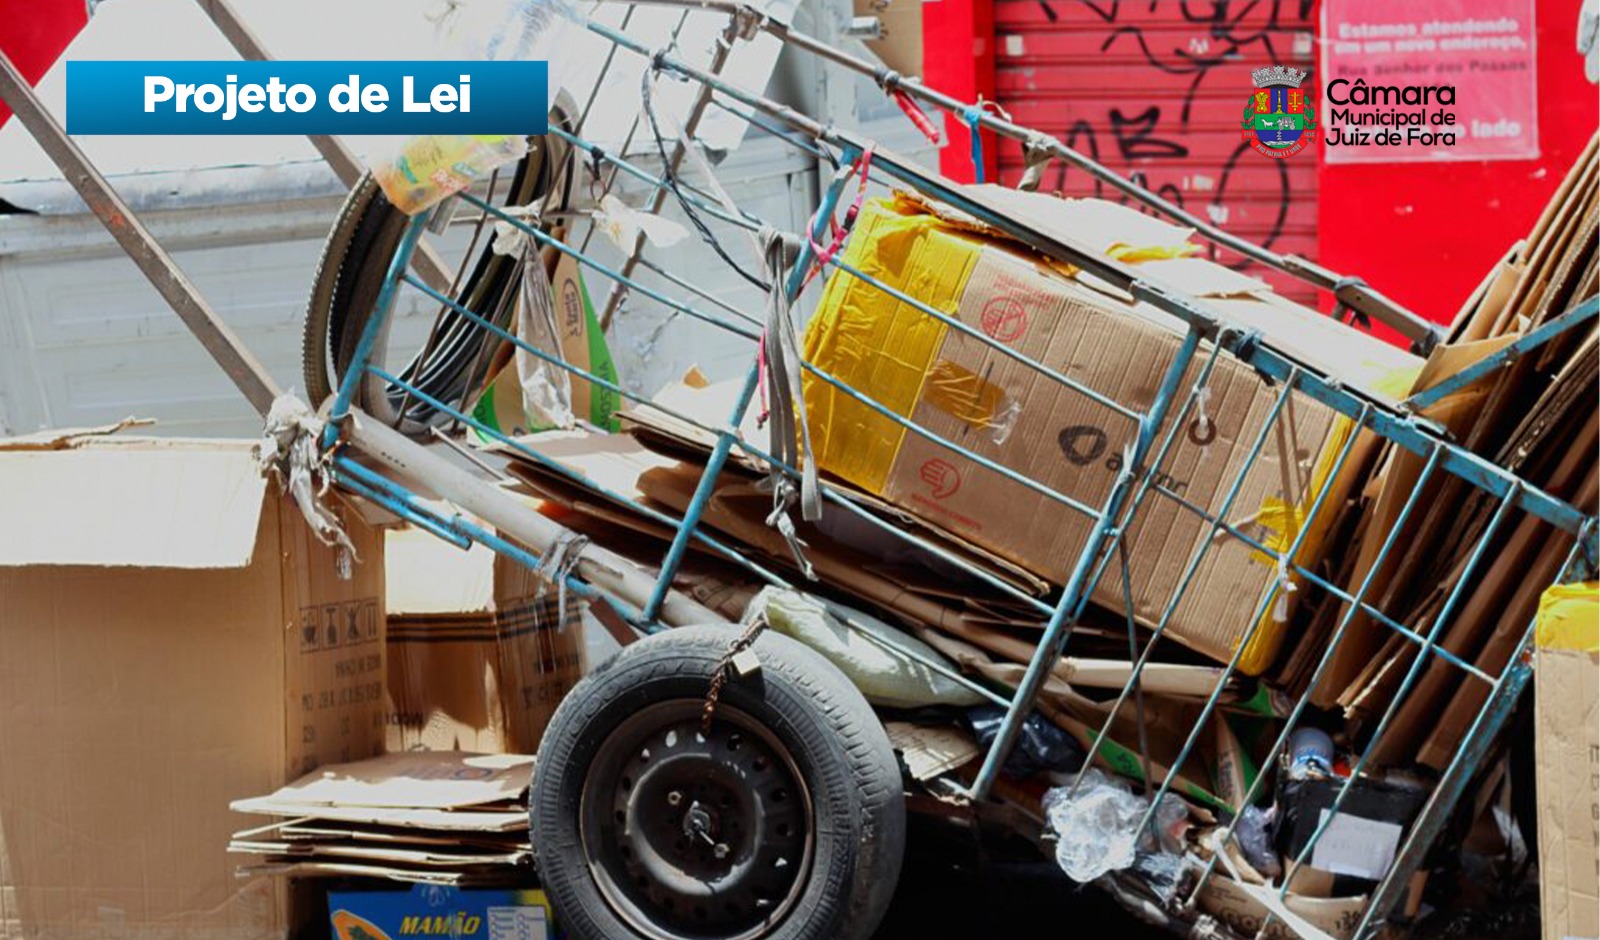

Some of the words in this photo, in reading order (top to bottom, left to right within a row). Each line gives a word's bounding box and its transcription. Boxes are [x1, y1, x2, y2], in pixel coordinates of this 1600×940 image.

[1338, 22, 1417, 39] Estamos
[1421, 18, 1519, 36] atendendo
[1334, 41, 1361, 55] em
[1395, 39, 1436, 53] novo
[1471, 118, 1522, 138] lado
[399, 911, 482, 935] MAMÃO
